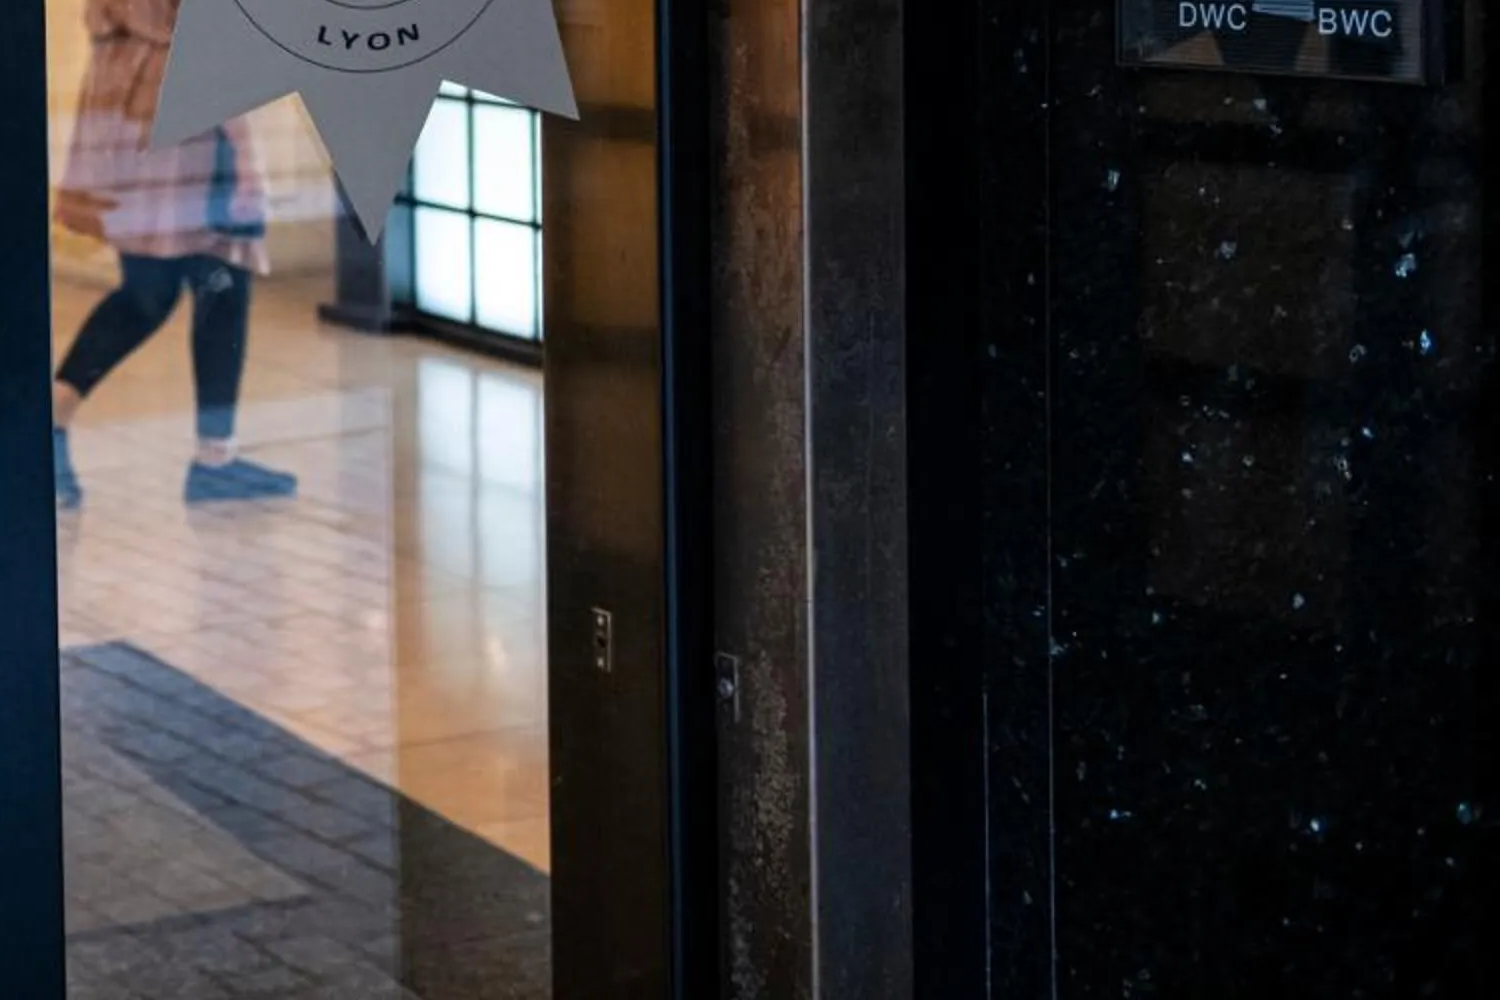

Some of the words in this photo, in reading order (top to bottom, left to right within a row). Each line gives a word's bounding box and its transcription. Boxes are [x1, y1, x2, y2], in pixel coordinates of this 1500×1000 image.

[1178, 1, 1248, 31] DWC
[1317, 7, 1394, 38] BWC
[316, 23, 420, 51] LYON
